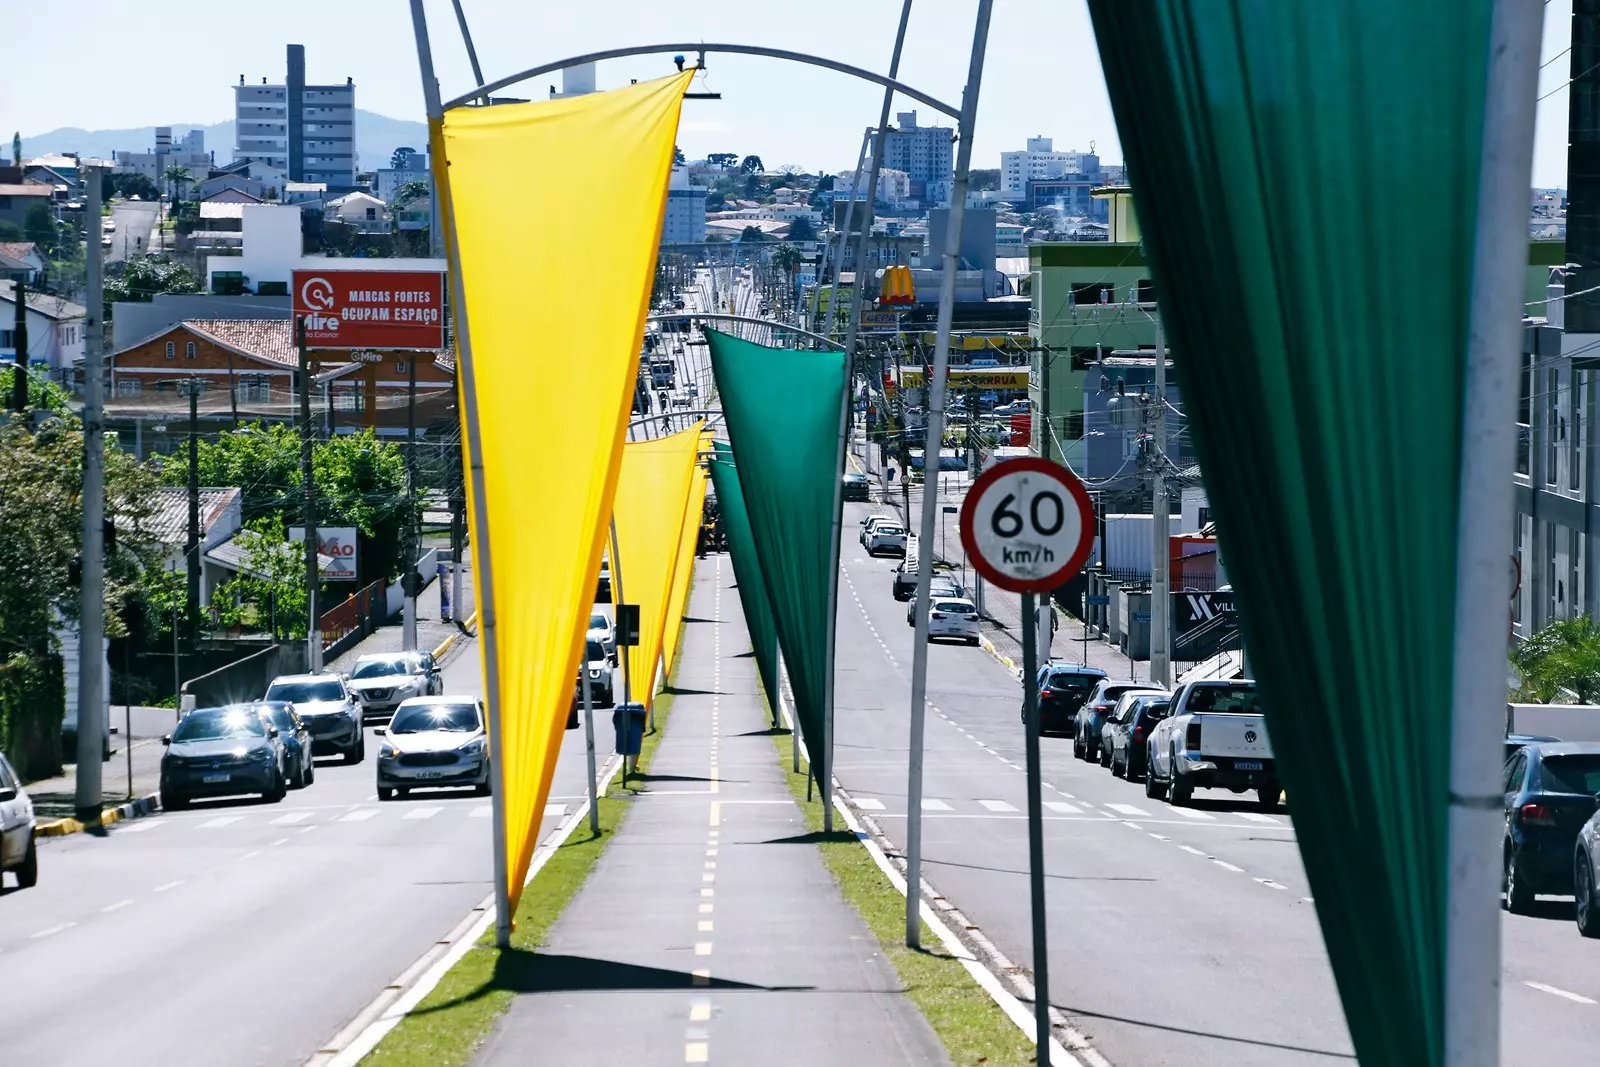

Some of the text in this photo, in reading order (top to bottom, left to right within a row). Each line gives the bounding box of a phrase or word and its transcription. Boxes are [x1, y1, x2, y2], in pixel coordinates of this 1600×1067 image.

[349, 290, 431, 303] MARCAS FORTES
[341, 307, 438, 325] OCUPAM ESPAÇO
[991, 490, 1065, 539] 60
[1002, 546, 1055, 564] km/h
